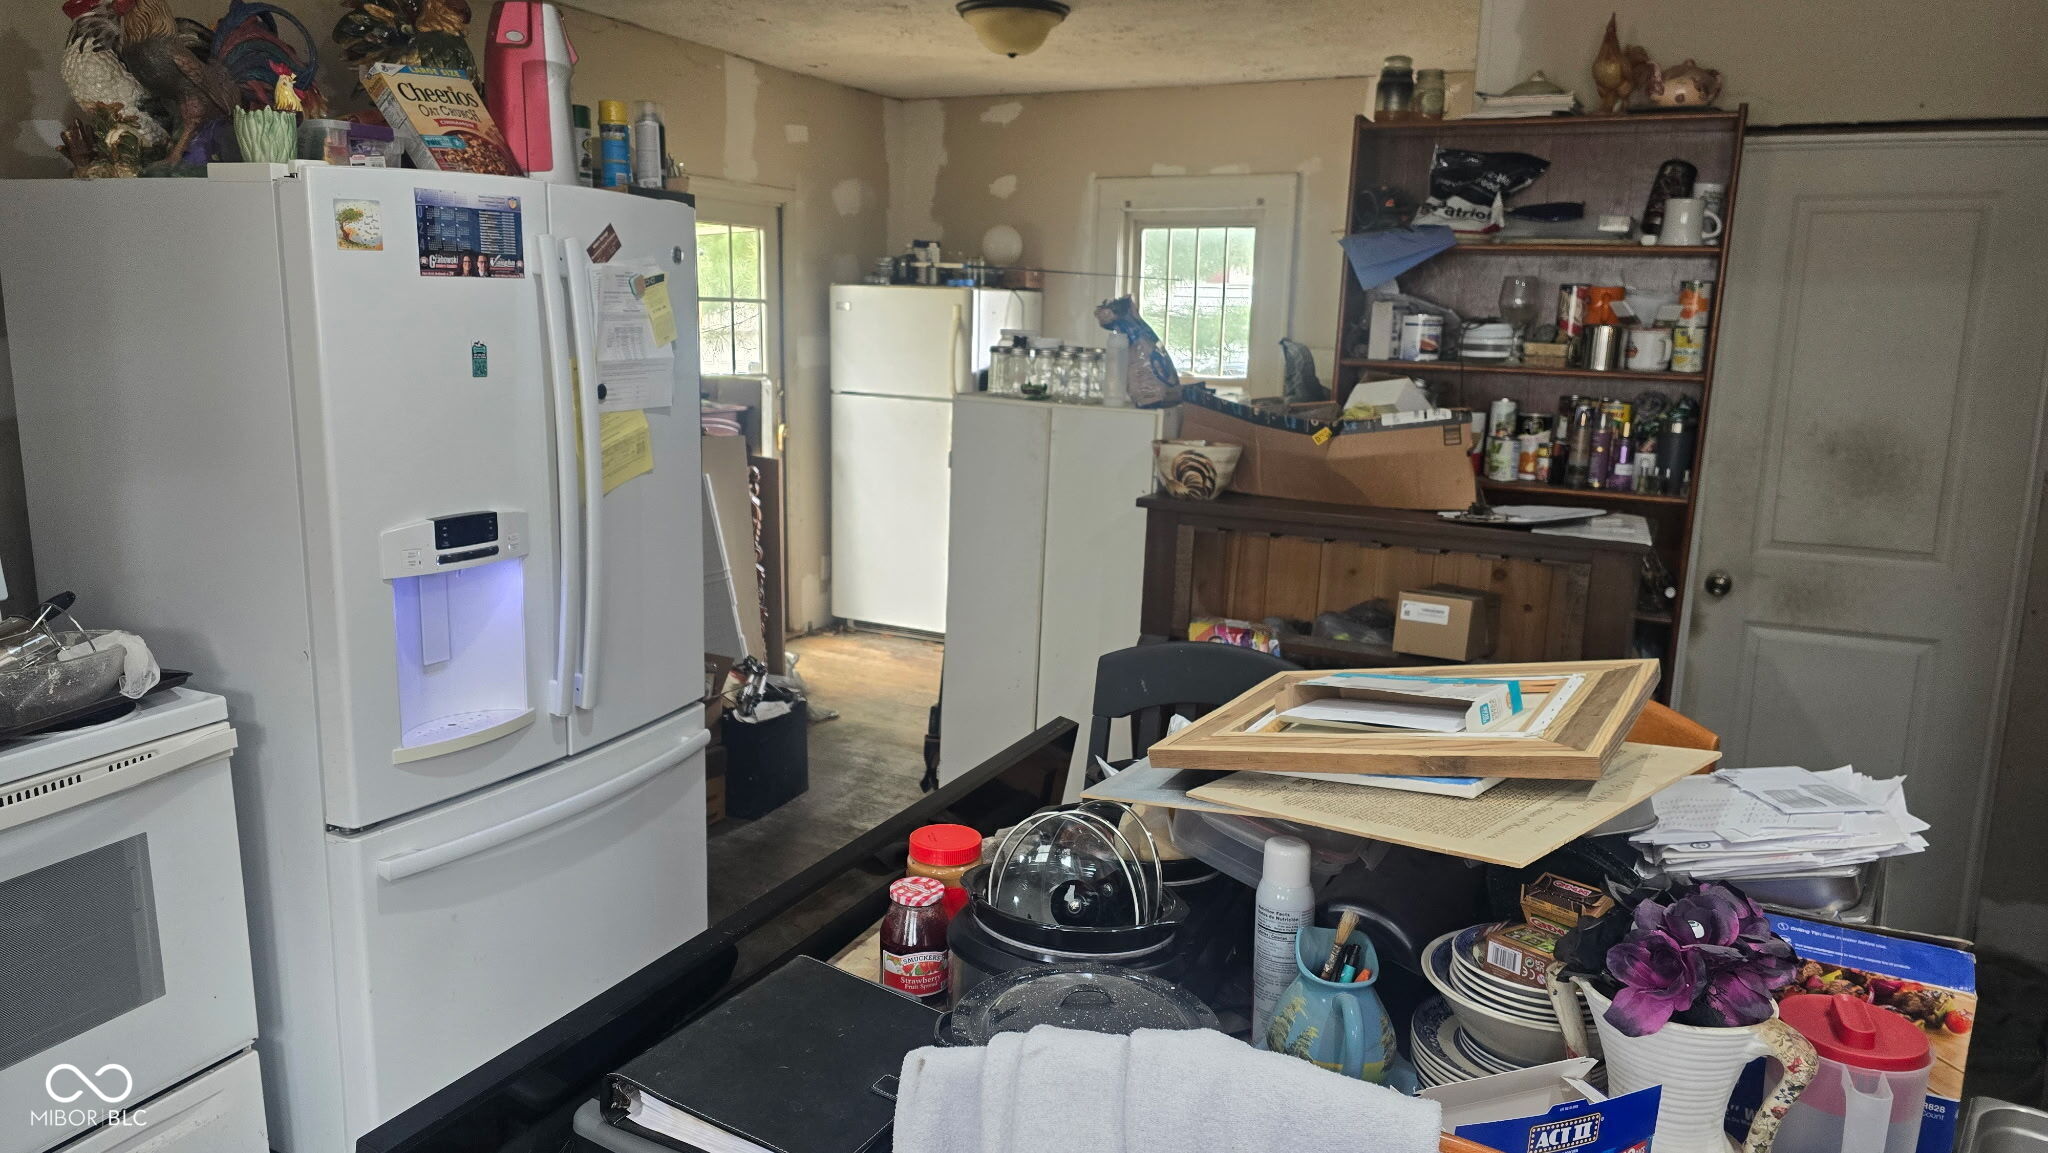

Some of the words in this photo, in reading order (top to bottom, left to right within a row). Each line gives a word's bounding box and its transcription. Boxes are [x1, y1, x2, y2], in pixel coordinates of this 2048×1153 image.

[398, 82, 478, 108] Cheerios
[418, 104, 440, 117] OAT
[900, 974, 941, 984] Strawberry
[920, 982, 938, 990] Spread
[1536, 1125, 1572, 1148] ACT
[1571, 1122, 1593, 1142] II
